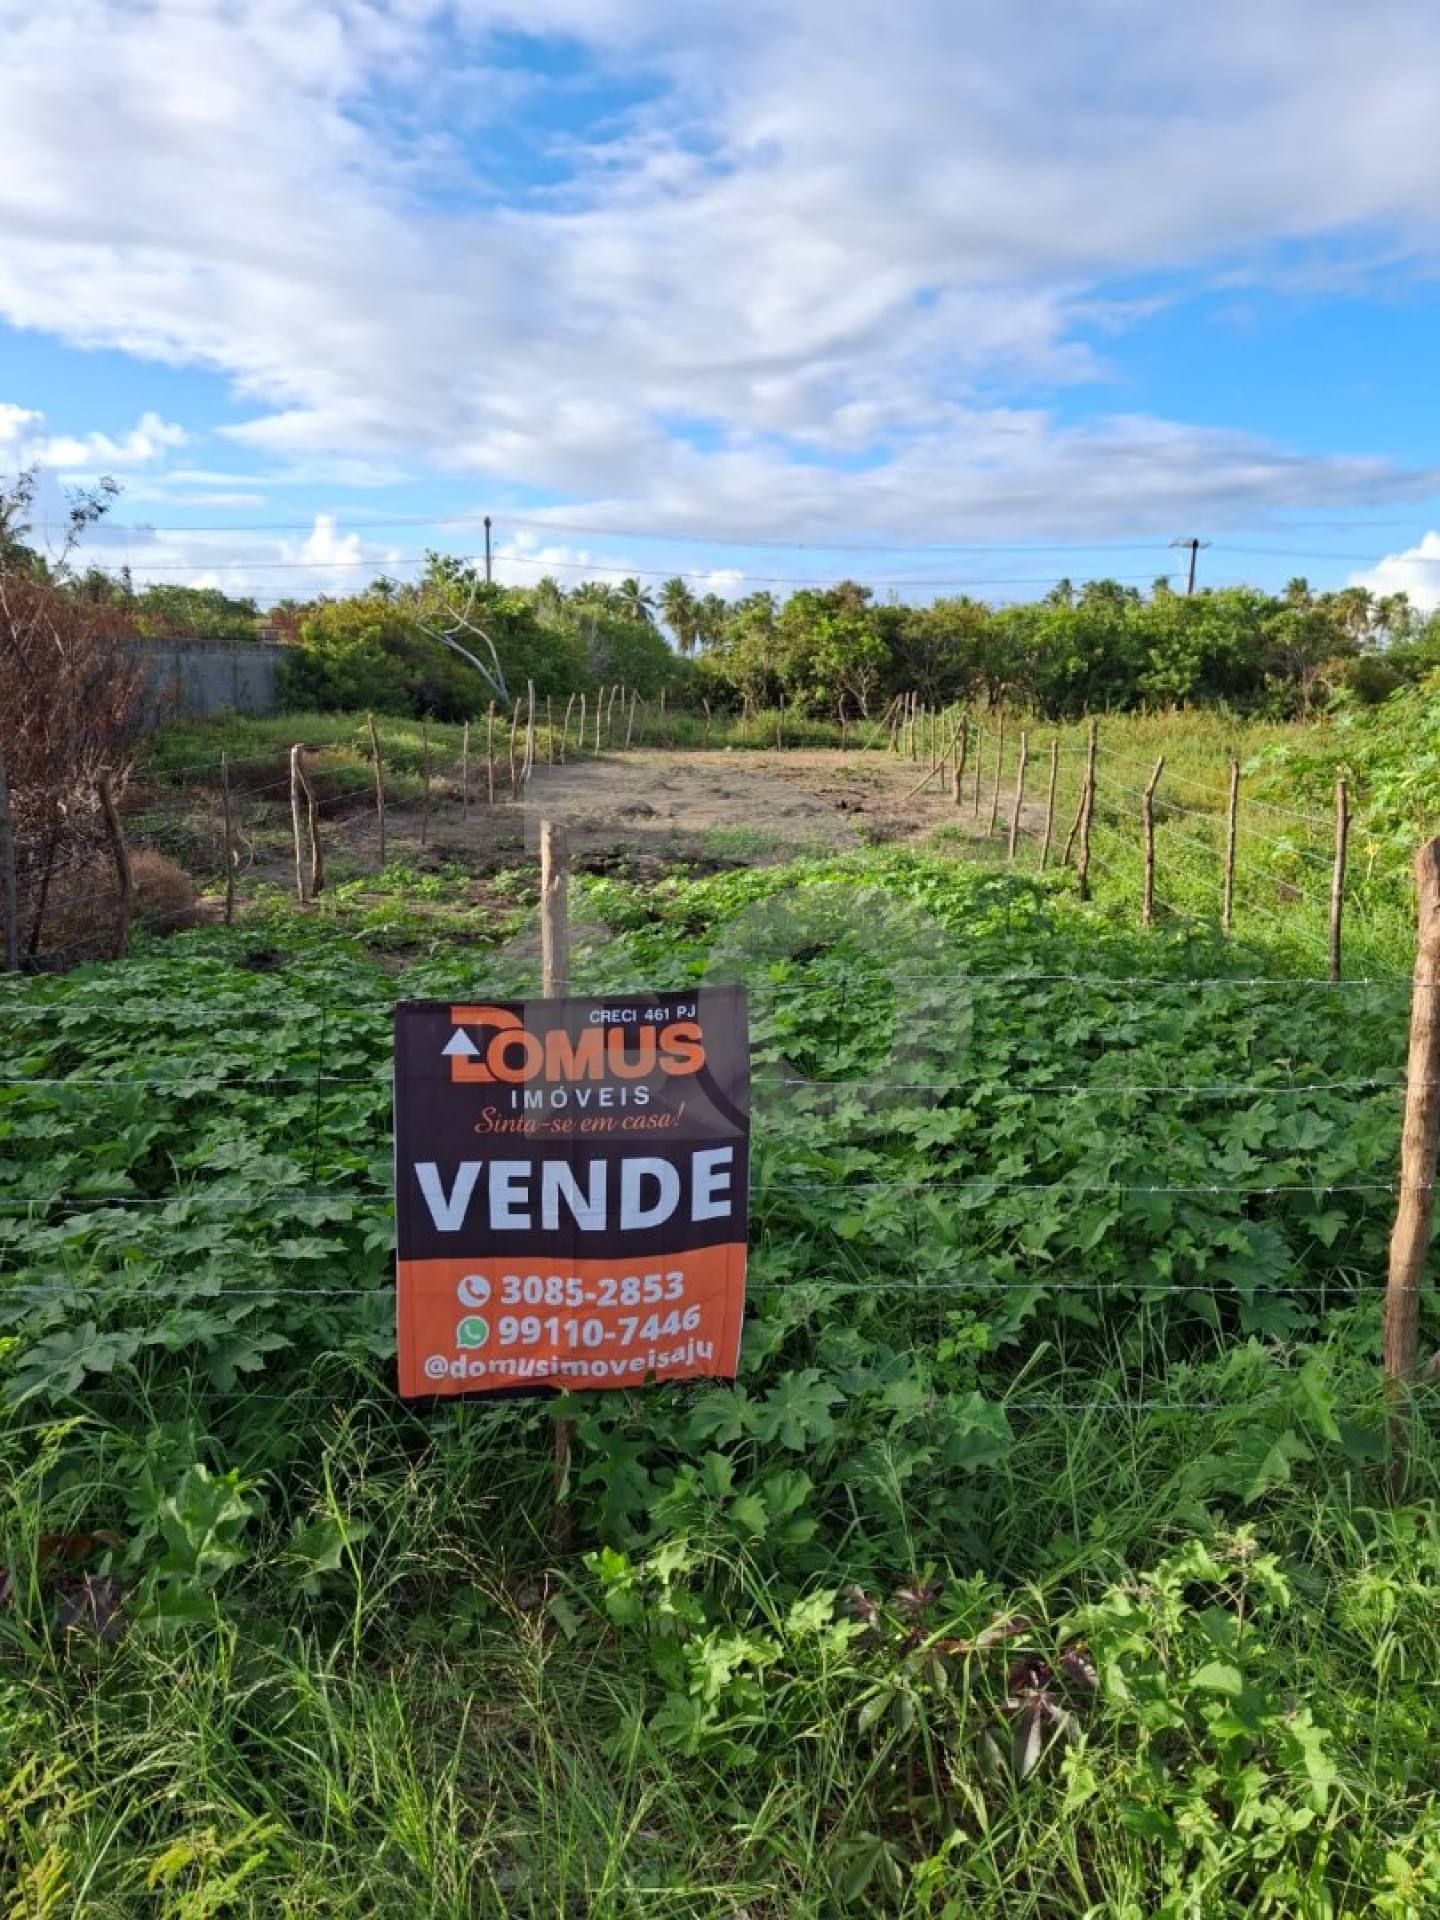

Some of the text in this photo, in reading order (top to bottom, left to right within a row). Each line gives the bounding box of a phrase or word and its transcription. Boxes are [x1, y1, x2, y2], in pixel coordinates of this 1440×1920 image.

[590, 1004, 697, 1024] CRECI 461 PJ
[449, 1005, 706, 1084] DOMUS
[511, 1085, 651, 1109] IMÓVEIS
[473, 1101, 686, 1134] Sinta-se em casa!
[413, 1145, 734, 1232] VENDE
[500, 1271, 685, 1307] 3085-2853
[498, 1304, 702, 1348] 99110-7446
[424, 1337, 714, 1380] @domusimoveisaju
